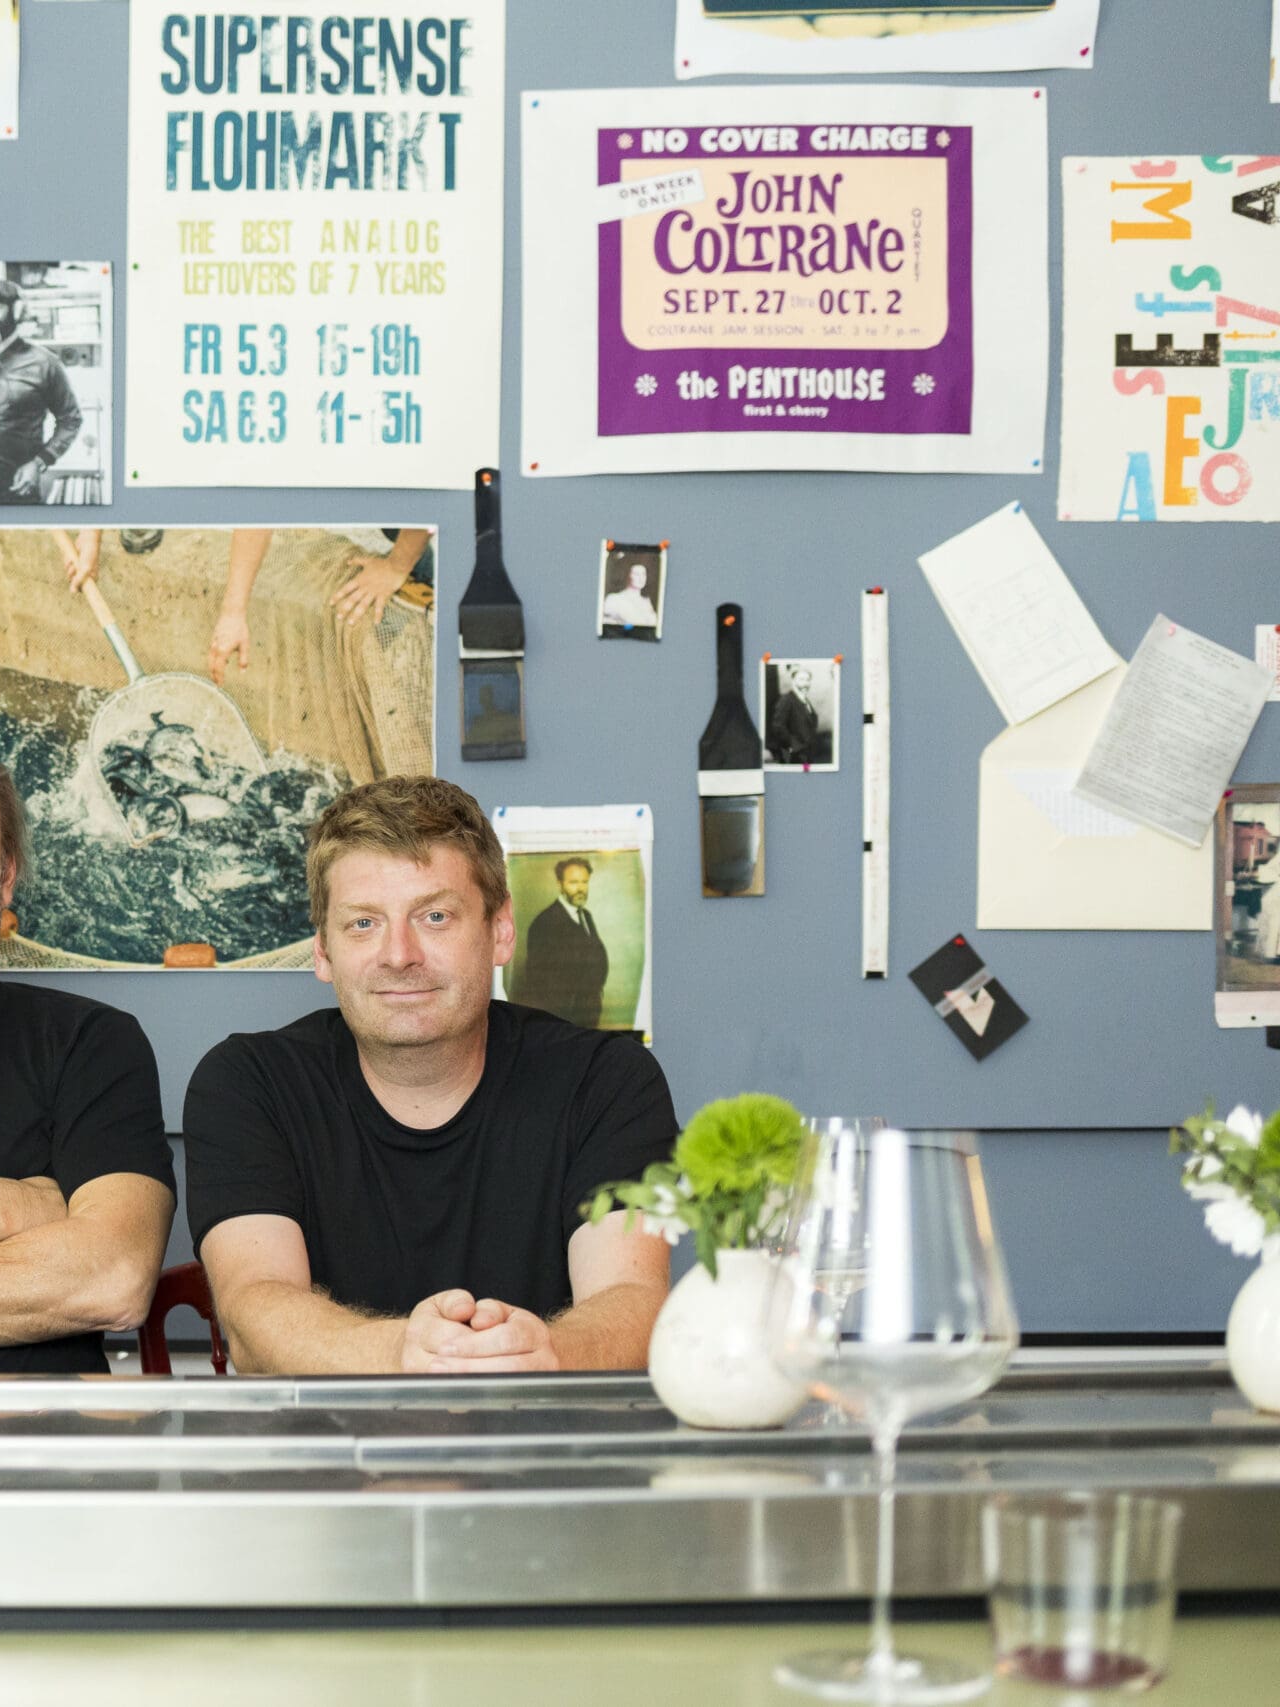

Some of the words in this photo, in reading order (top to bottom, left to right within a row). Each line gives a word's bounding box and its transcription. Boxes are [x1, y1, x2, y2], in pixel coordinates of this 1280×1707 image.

[160, 14, 474, 96] SUPERSENSE
[165, 110, 462, 192] FLOHMARKT
[642, 129, 688, 153] NO
[700, 128, 798, 153] COVER
[810, 127, 927, 151] CHARGE
[620, 185, 648, 199] ONE
[655, 176, 695, 191] WEEK
[638, 190, 685, 208] ONLY!
[717, 171, 843, 218] JOHN
[177, 220, 215, 254] THE
[241, 220, 293, 254] BEST
[320, 220, 440, 254] ANALOG
[183, 262, 296, 295] LEFTOVERS
[309, 262, 334, 295] OF
[347, 264, 359, 294] 7
[375, 262, 446, 295] YEARS
[663, 290, 748, 315] SEPT.
[756, 290, 785, 315] 27
[819, 289, 877, 315] OCT.
[886, 290, 902, 315] 2
[648, 324, 714, 336] COLTRANE
[721, 324, 748, 336] JAM
[753, 324, 804, 336] SESSION
[183, 323, 221, 375] FR
[238, 323, 287, 376] 5.3
[676, 371, 719, 400] the
[728, 365, 885, 401] PENTHOUSE
[182, 390, 228, 443] SA
[238, 390, 287, 443] 6.3
[743, 404, 772, 417] first
[775, 405, 786, 417] &
[789, 405, 829, 418] cherry
